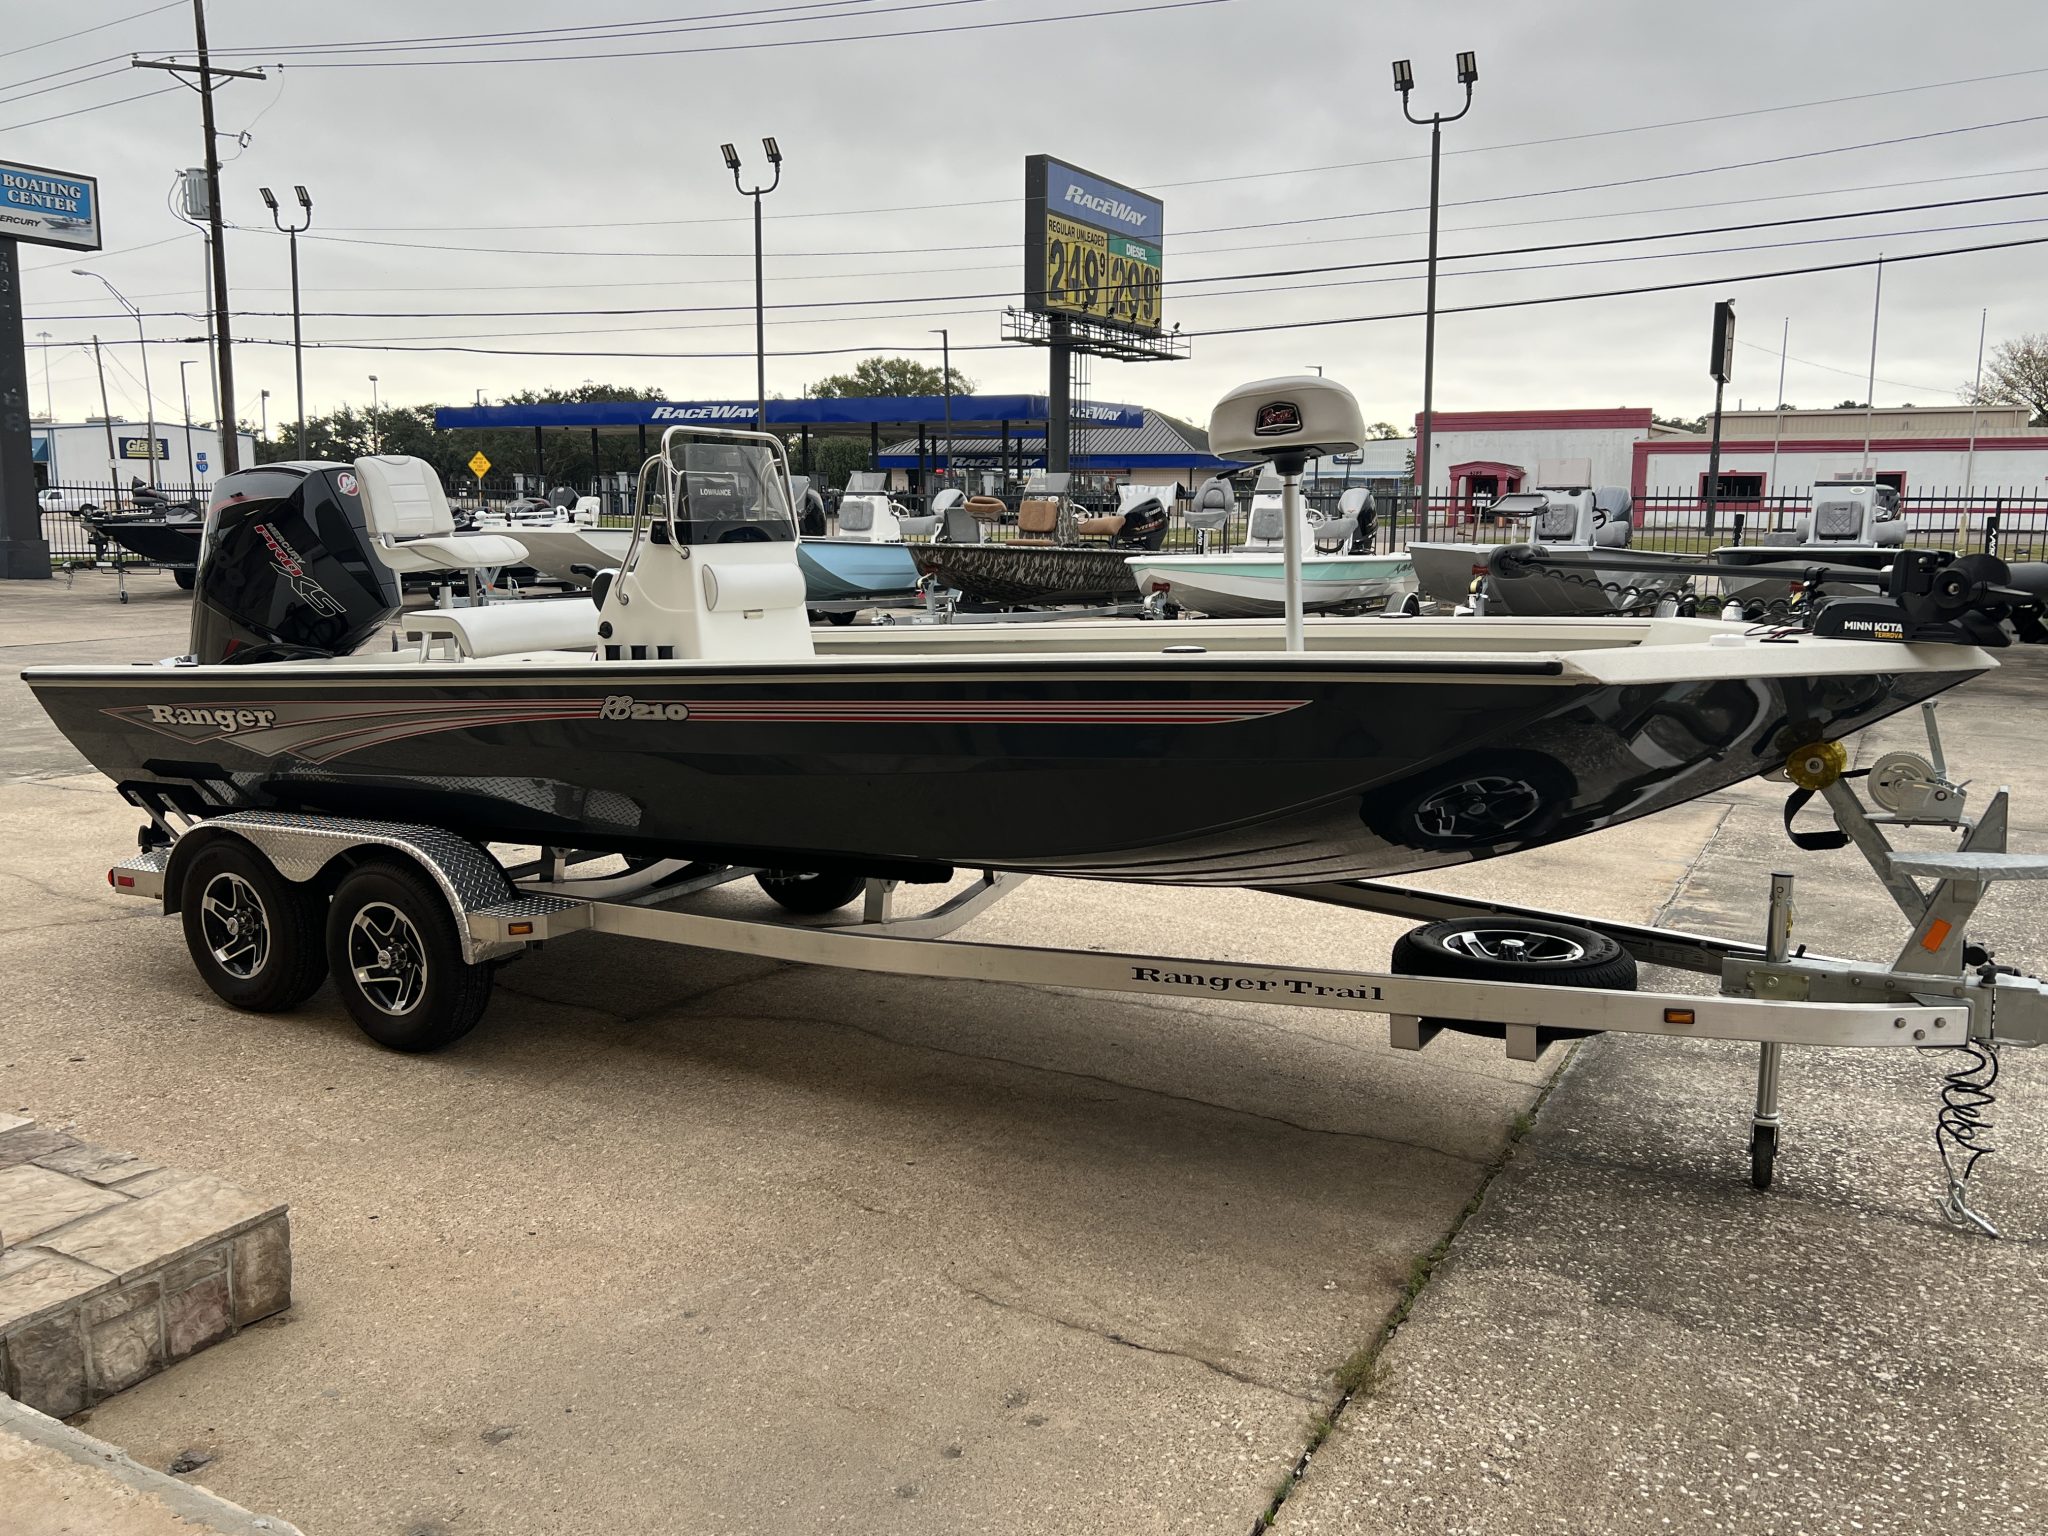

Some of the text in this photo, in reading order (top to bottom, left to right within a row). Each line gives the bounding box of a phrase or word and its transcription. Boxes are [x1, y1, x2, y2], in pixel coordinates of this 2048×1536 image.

[2, 173, 81, 199] BOATING
[7, 189, 78, 212] CENTER
[0, 214, 41, 227] ERCURY
[1048, 219, 1105, 247] REGULAR UNLEADED
[1126, 243, 1148, 261] DIESEL
[125, 439, 163, 452] Glas
[700, 488, 732, 497] LOWRANCE
[254, 524, 304, 577] PRO
[266, 522, 306, 564] MERCURY
[1844, 621, 1903, 633] MINN KOTA
[146, 704, 275, 733] Ranger
[1131, 967, 1385, 1001] Ranger Trail
